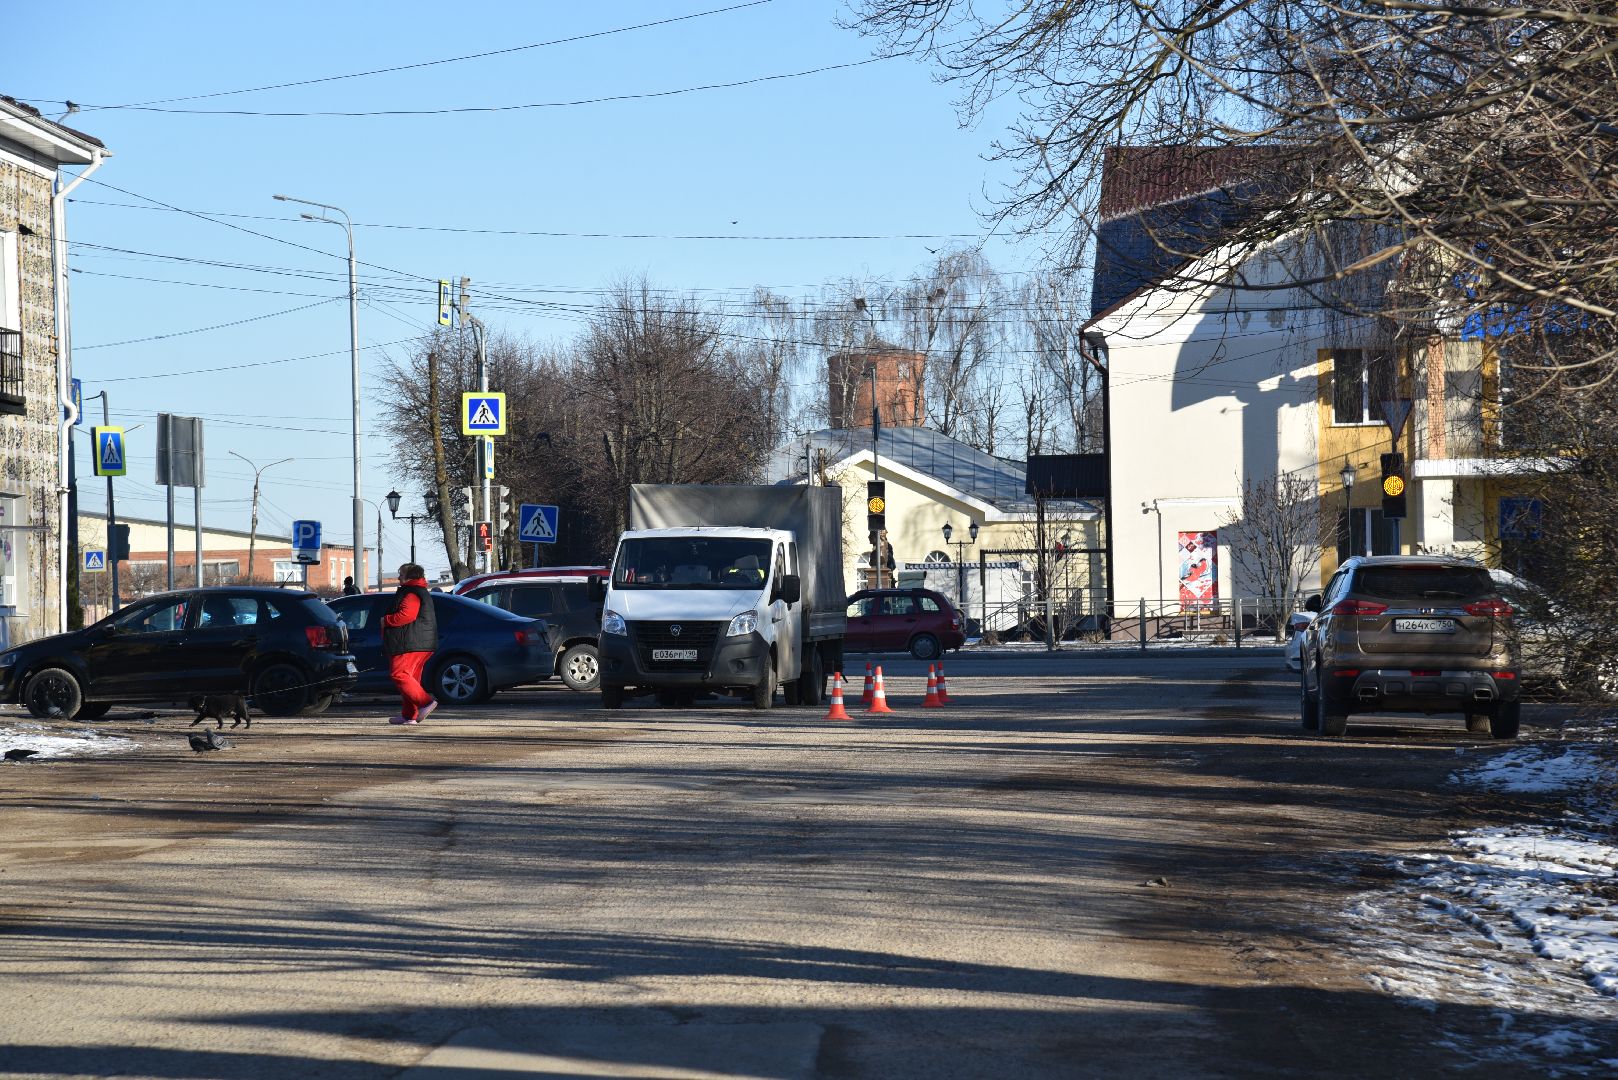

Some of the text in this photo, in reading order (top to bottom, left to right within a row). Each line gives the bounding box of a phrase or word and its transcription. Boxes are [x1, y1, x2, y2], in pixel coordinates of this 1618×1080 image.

[298, 523, 315, 547] P
[485, 537, 493, 552] 5
[1398, 620, 1452, 630] Н264ХС 750
